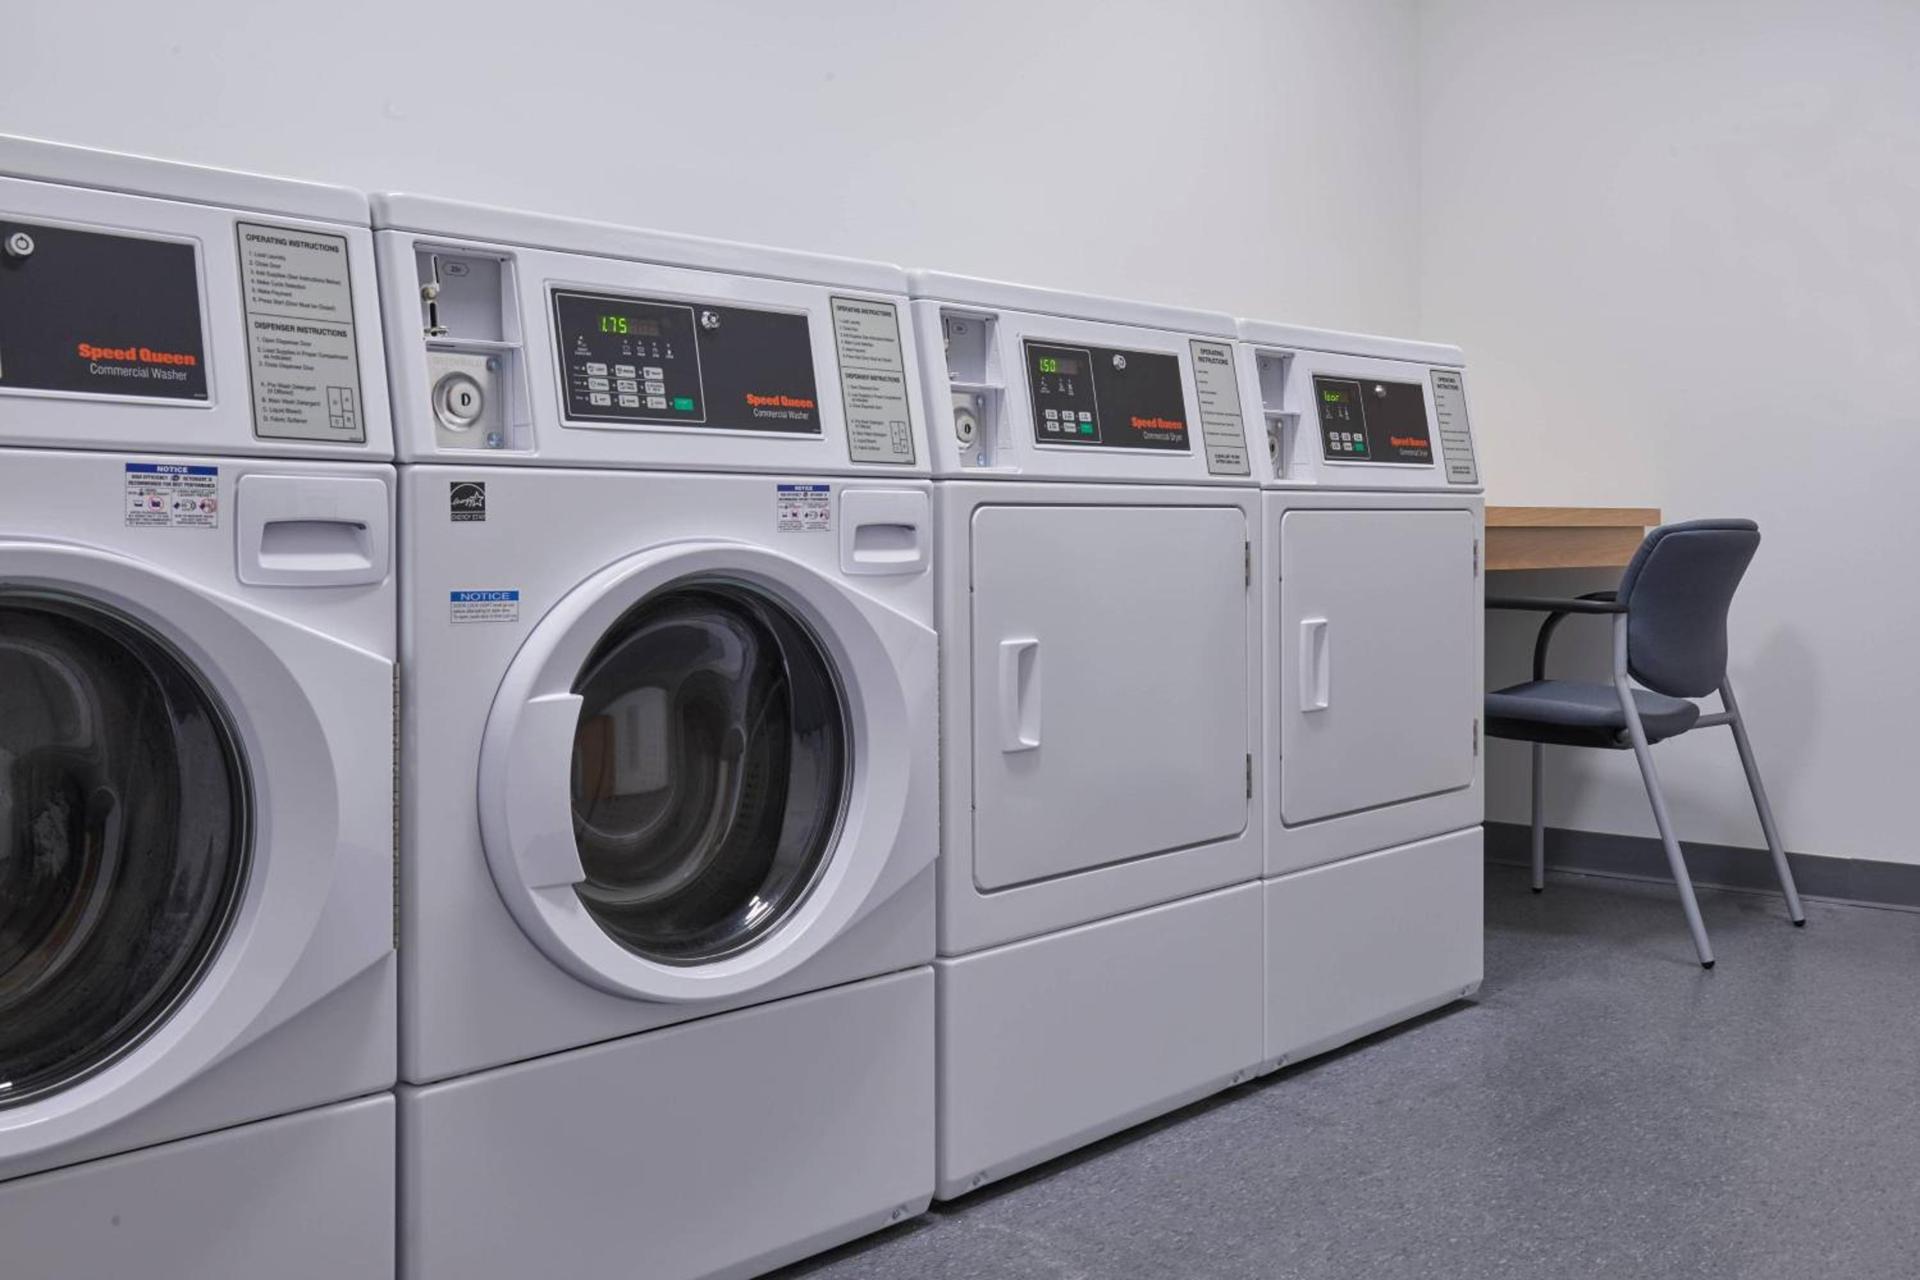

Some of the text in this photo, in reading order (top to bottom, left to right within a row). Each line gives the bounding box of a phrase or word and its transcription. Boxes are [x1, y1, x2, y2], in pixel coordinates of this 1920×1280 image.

[246, 234, 339, 253] OPERATING INSTRUCTIONS
[255, 322, 347, 338] DISPENSER INSTRUCTIONS
[78, 342, 196, 366] Speed Queen
[90, 363, 187, 380] Commercial Washer
[747, 394, 813, 408] Speed Queen
[753, 408, 809, 420] Commercial Washer
[1131, 416, 1182, 429] Speed Queen
